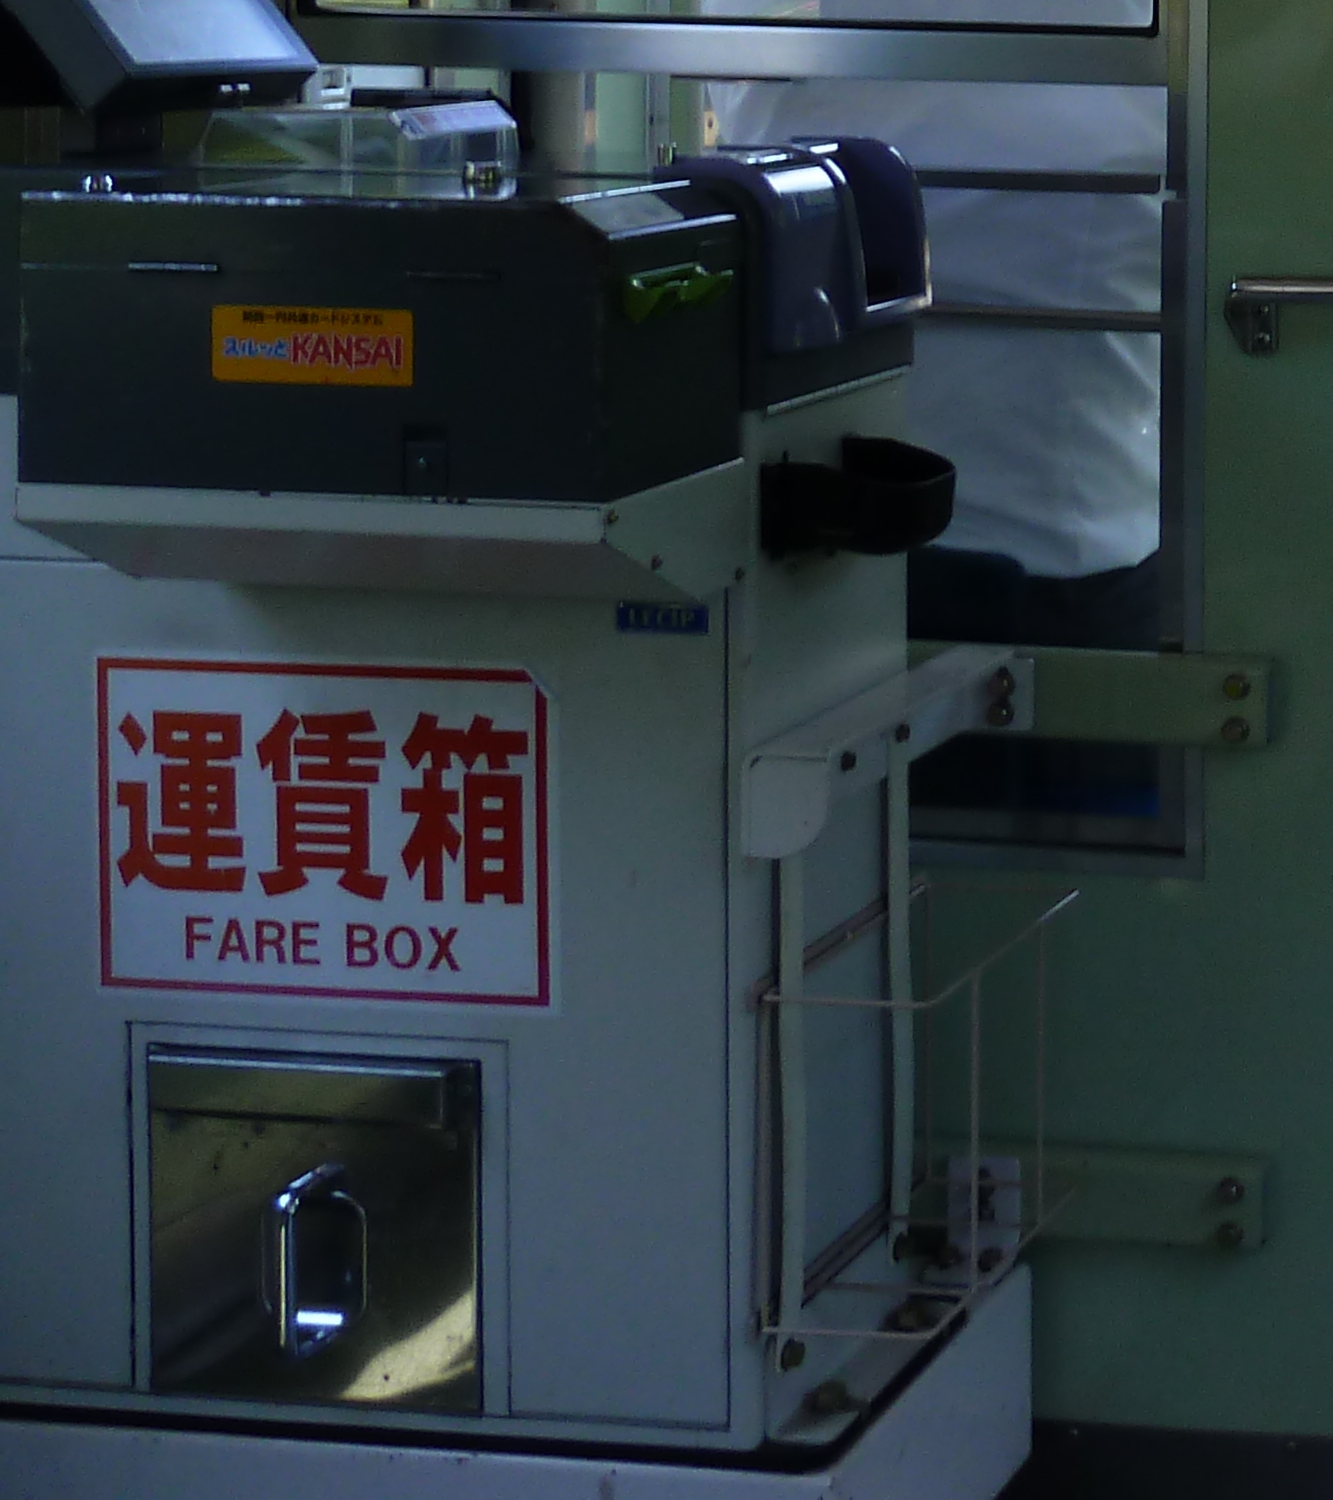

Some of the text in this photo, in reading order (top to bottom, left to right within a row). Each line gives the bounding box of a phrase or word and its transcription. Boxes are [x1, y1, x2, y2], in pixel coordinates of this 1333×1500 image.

[116, 708, 528, 904] 運賃箱
[184, 916, 461, 972] FARE BOX
